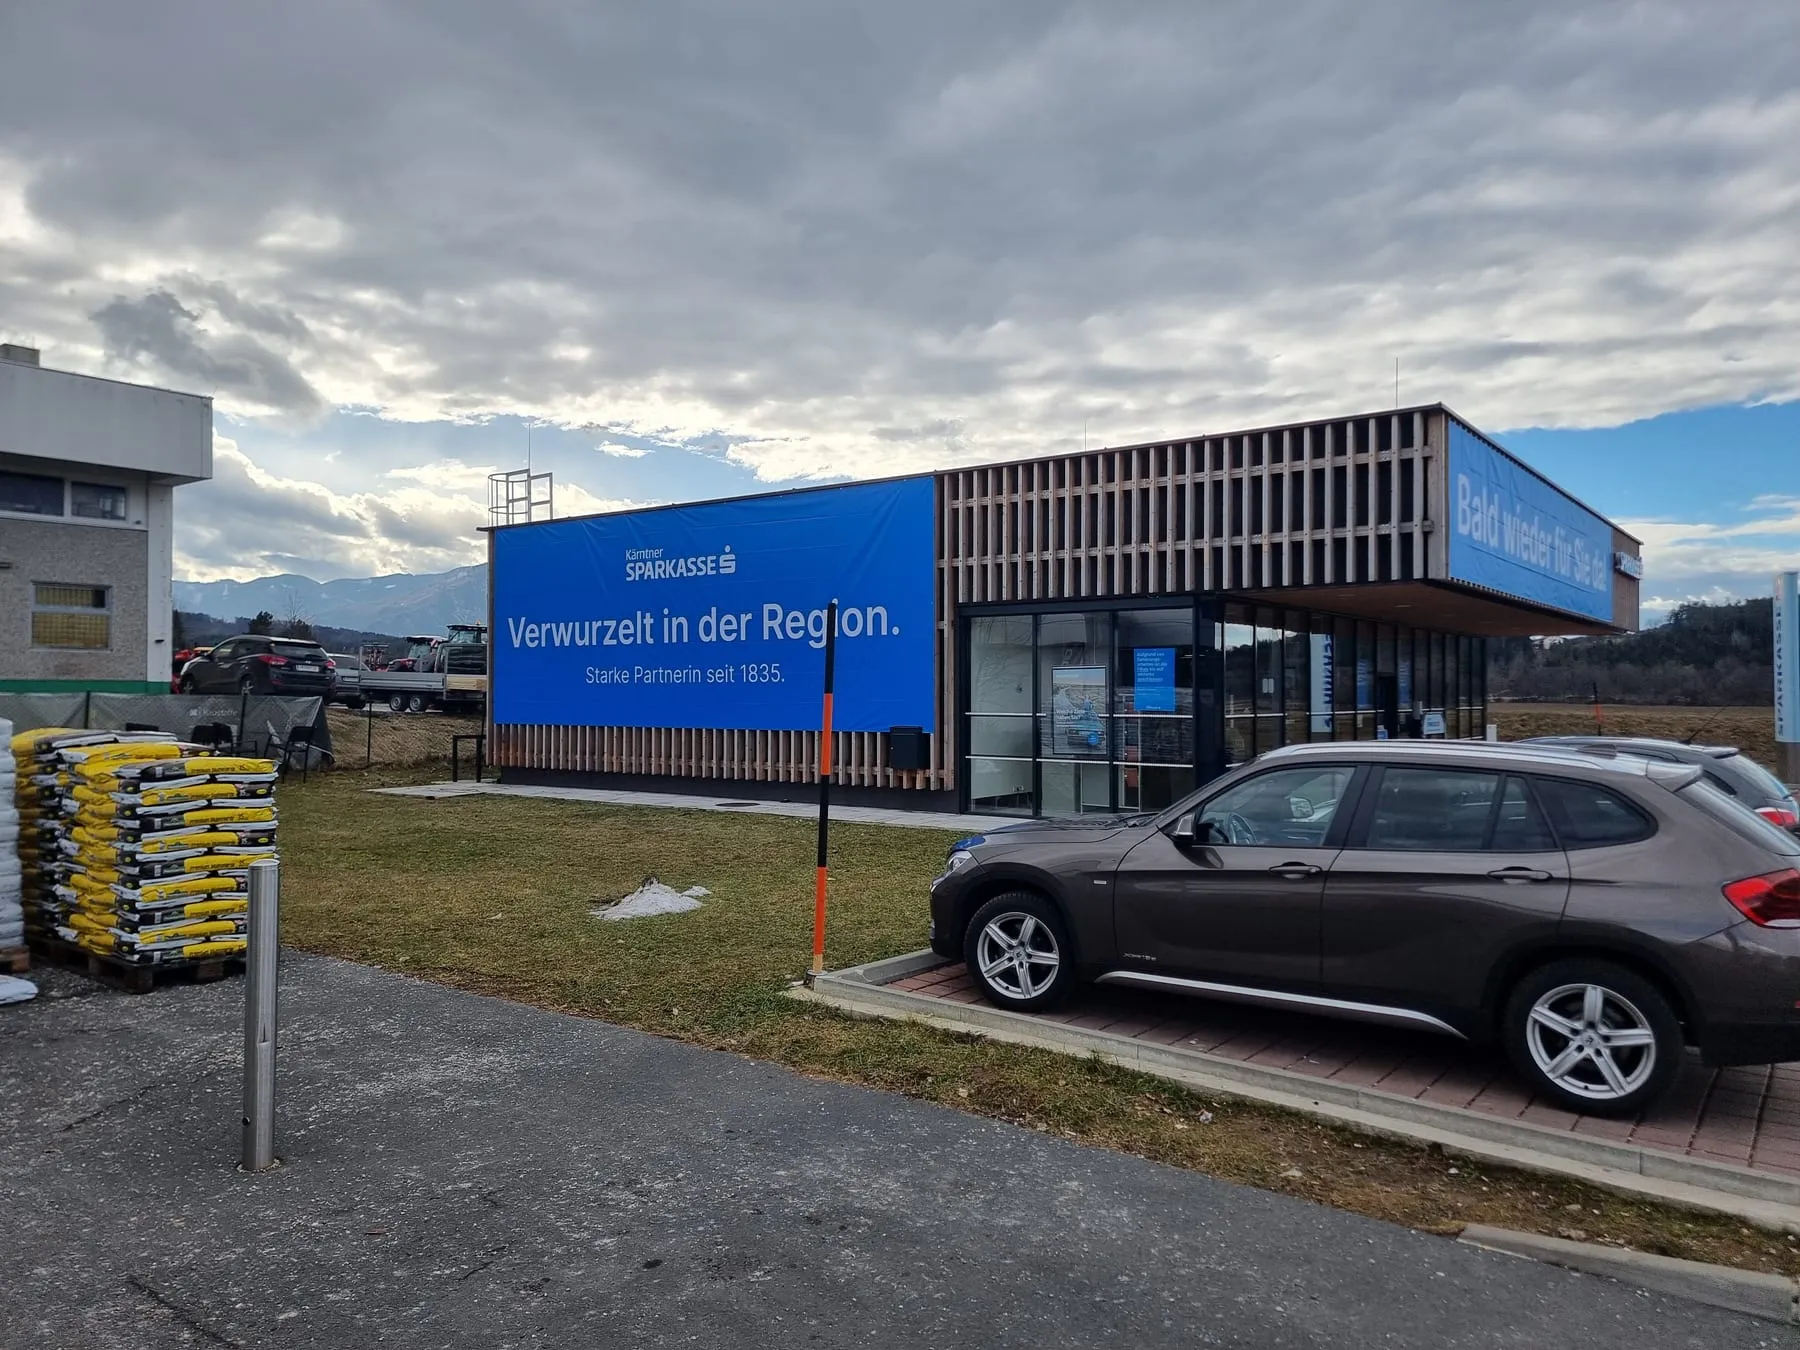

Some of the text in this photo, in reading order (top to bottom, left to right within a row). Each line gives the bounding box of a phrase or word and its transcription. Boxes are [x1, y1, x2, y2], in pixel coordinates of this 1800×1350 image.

[1457, 472, 1499, 549] Bald
[1503, 503, 1552, 570] wieder
[1554, 525, 1571, 578] für
[625, 548, 664, 561] Kärntner
[625, 555, 717, 581] SPARKASSE
[507, 610, 655, 649] Verwurzelt
[663, 607, 689, 644] in
[698, 606, 753, 643] der
[585, 663, 785, 685] Starke Partnerin seit 1835.
